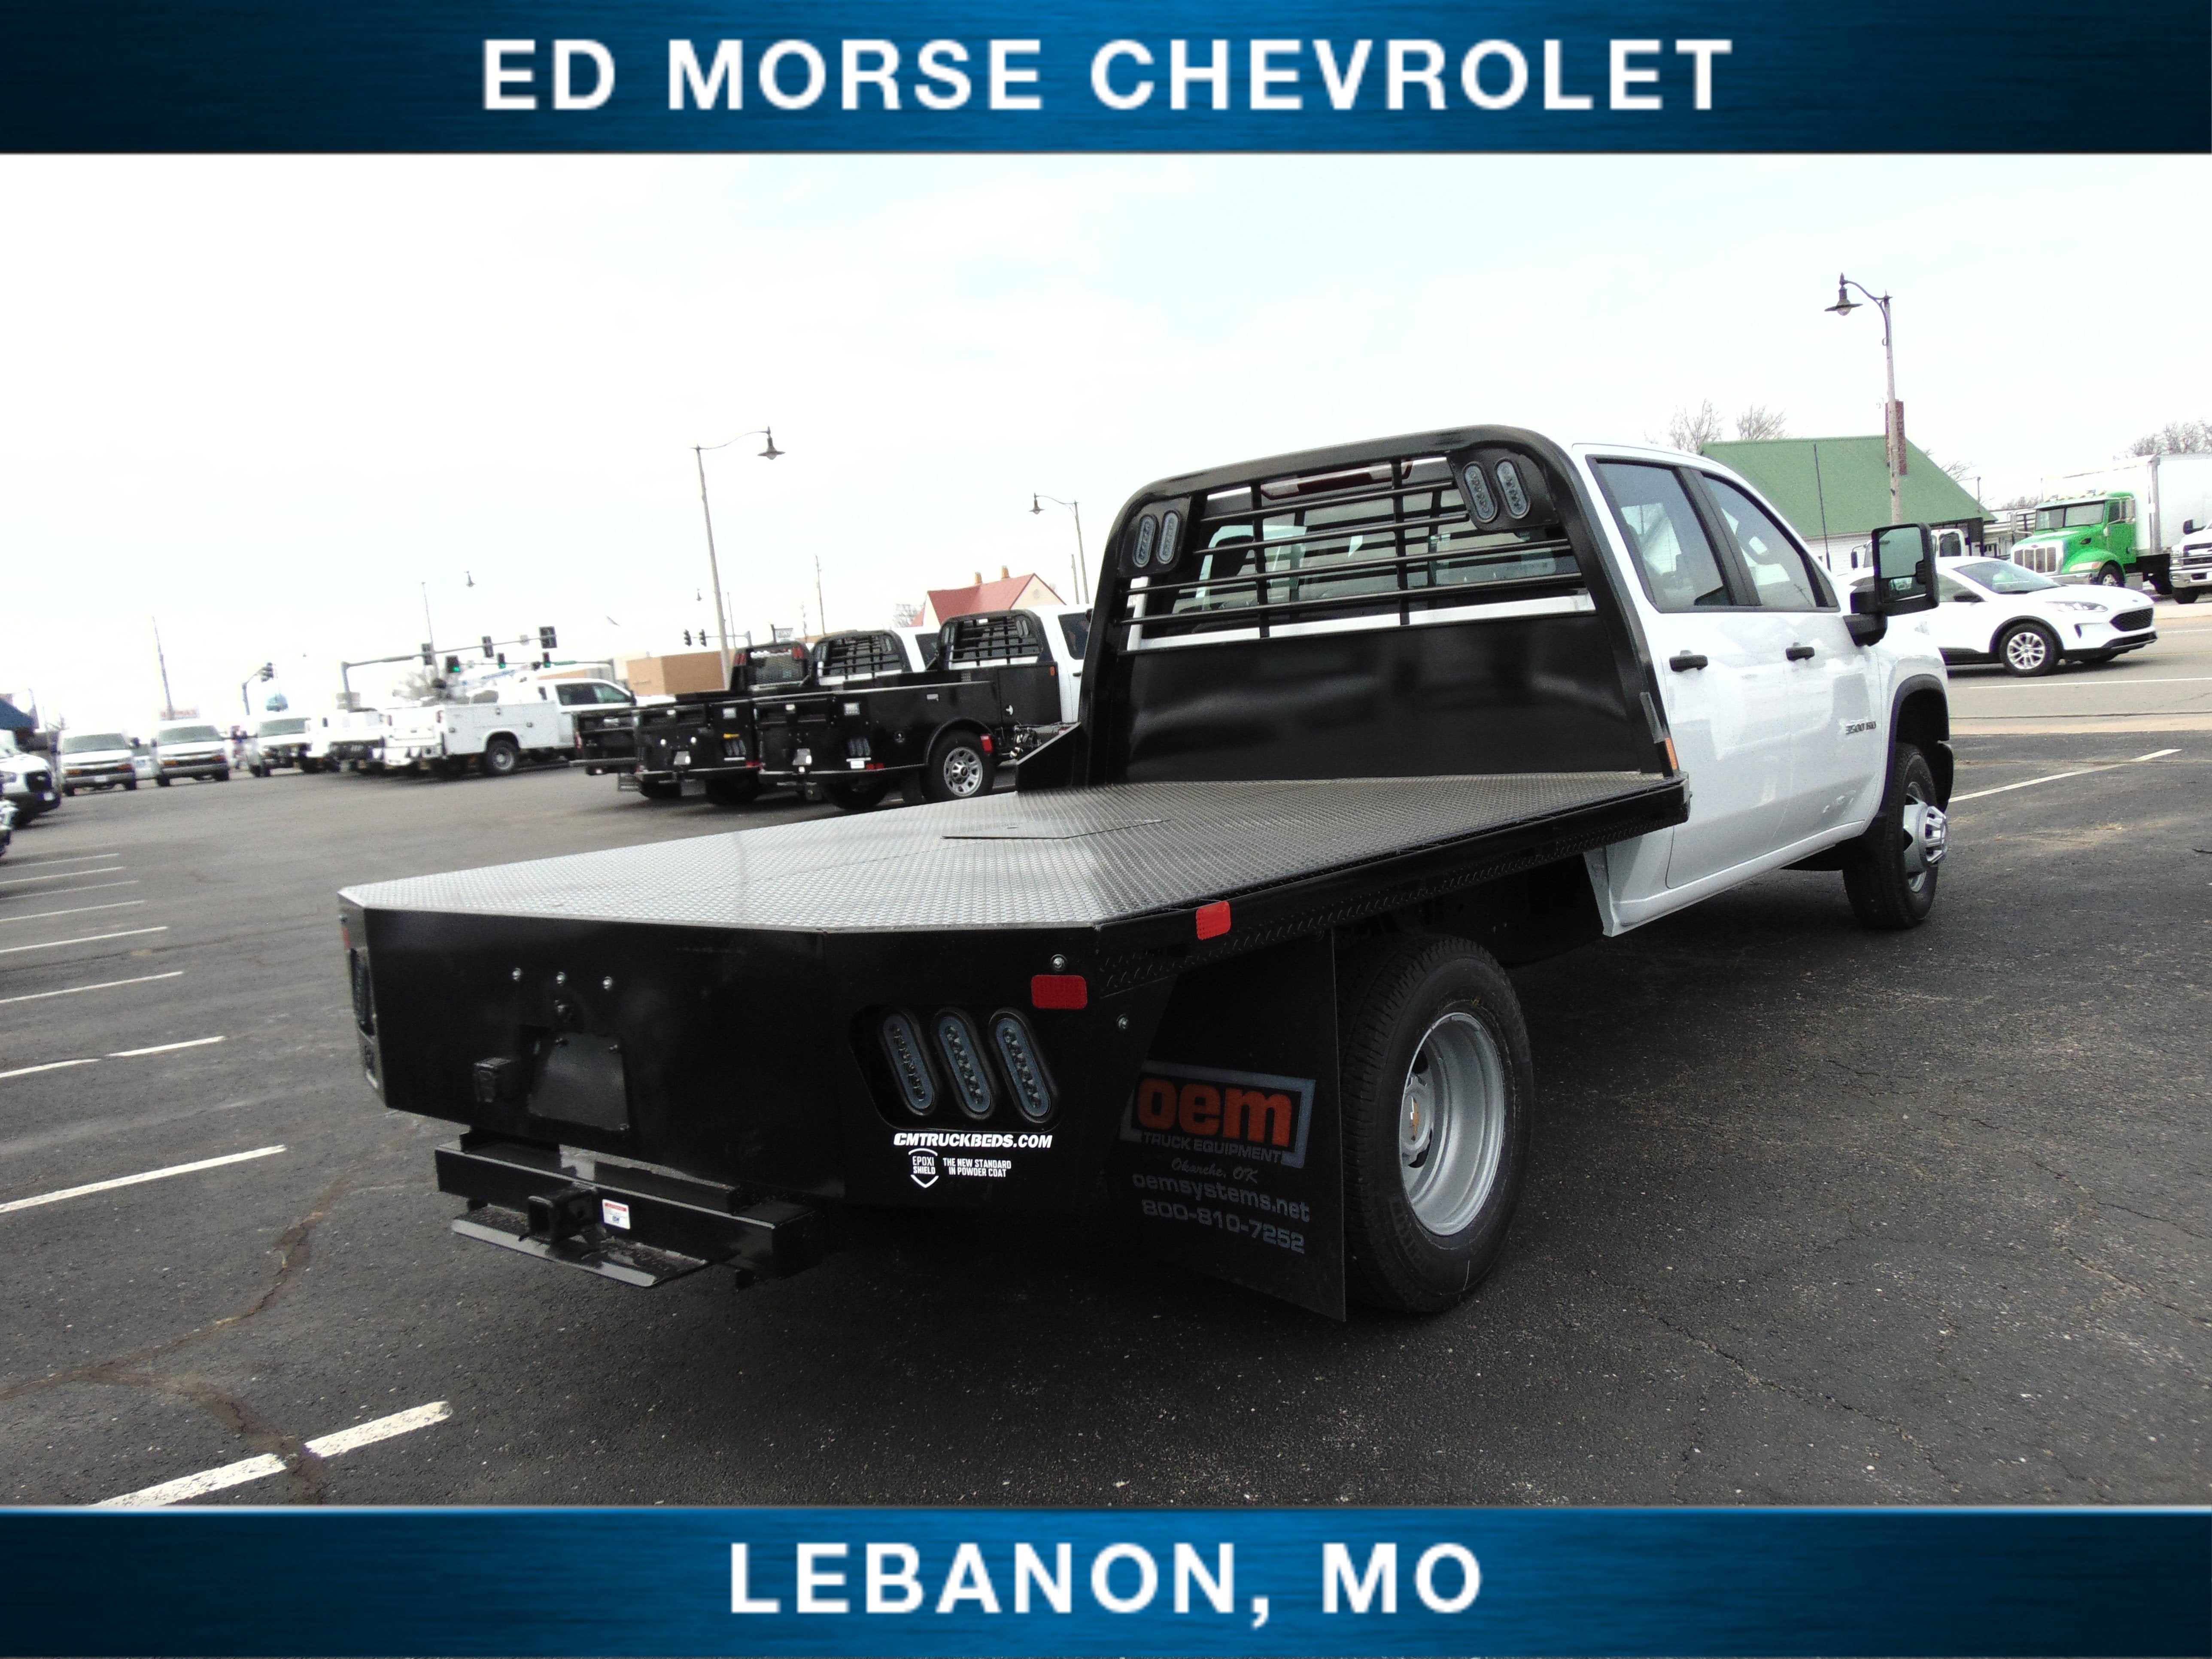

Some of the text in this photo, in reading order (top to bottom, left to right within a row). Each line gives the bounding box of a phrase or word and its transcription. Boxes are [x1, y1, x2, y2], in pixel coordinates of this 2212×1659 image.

[1138, 1078, 1292, 1147] oem
[1142, 1132, 1282, 1163] TRUCK EQUIPMENT
[912, 1155, 935, 1167] EPOXI
[942, 1157, 1012, 1170] THE NEW STANDARD
[913, 1166, 936, 1175] SHIELD
[948, 1167, 1007, 1178] IN POWDER COAT
[1232, 1166, 1258, 1184] OK
[1132, 1173, 1310, 1223] oemsystems.net
[1141, 1198, 1305, 1254] 800-810-7252
